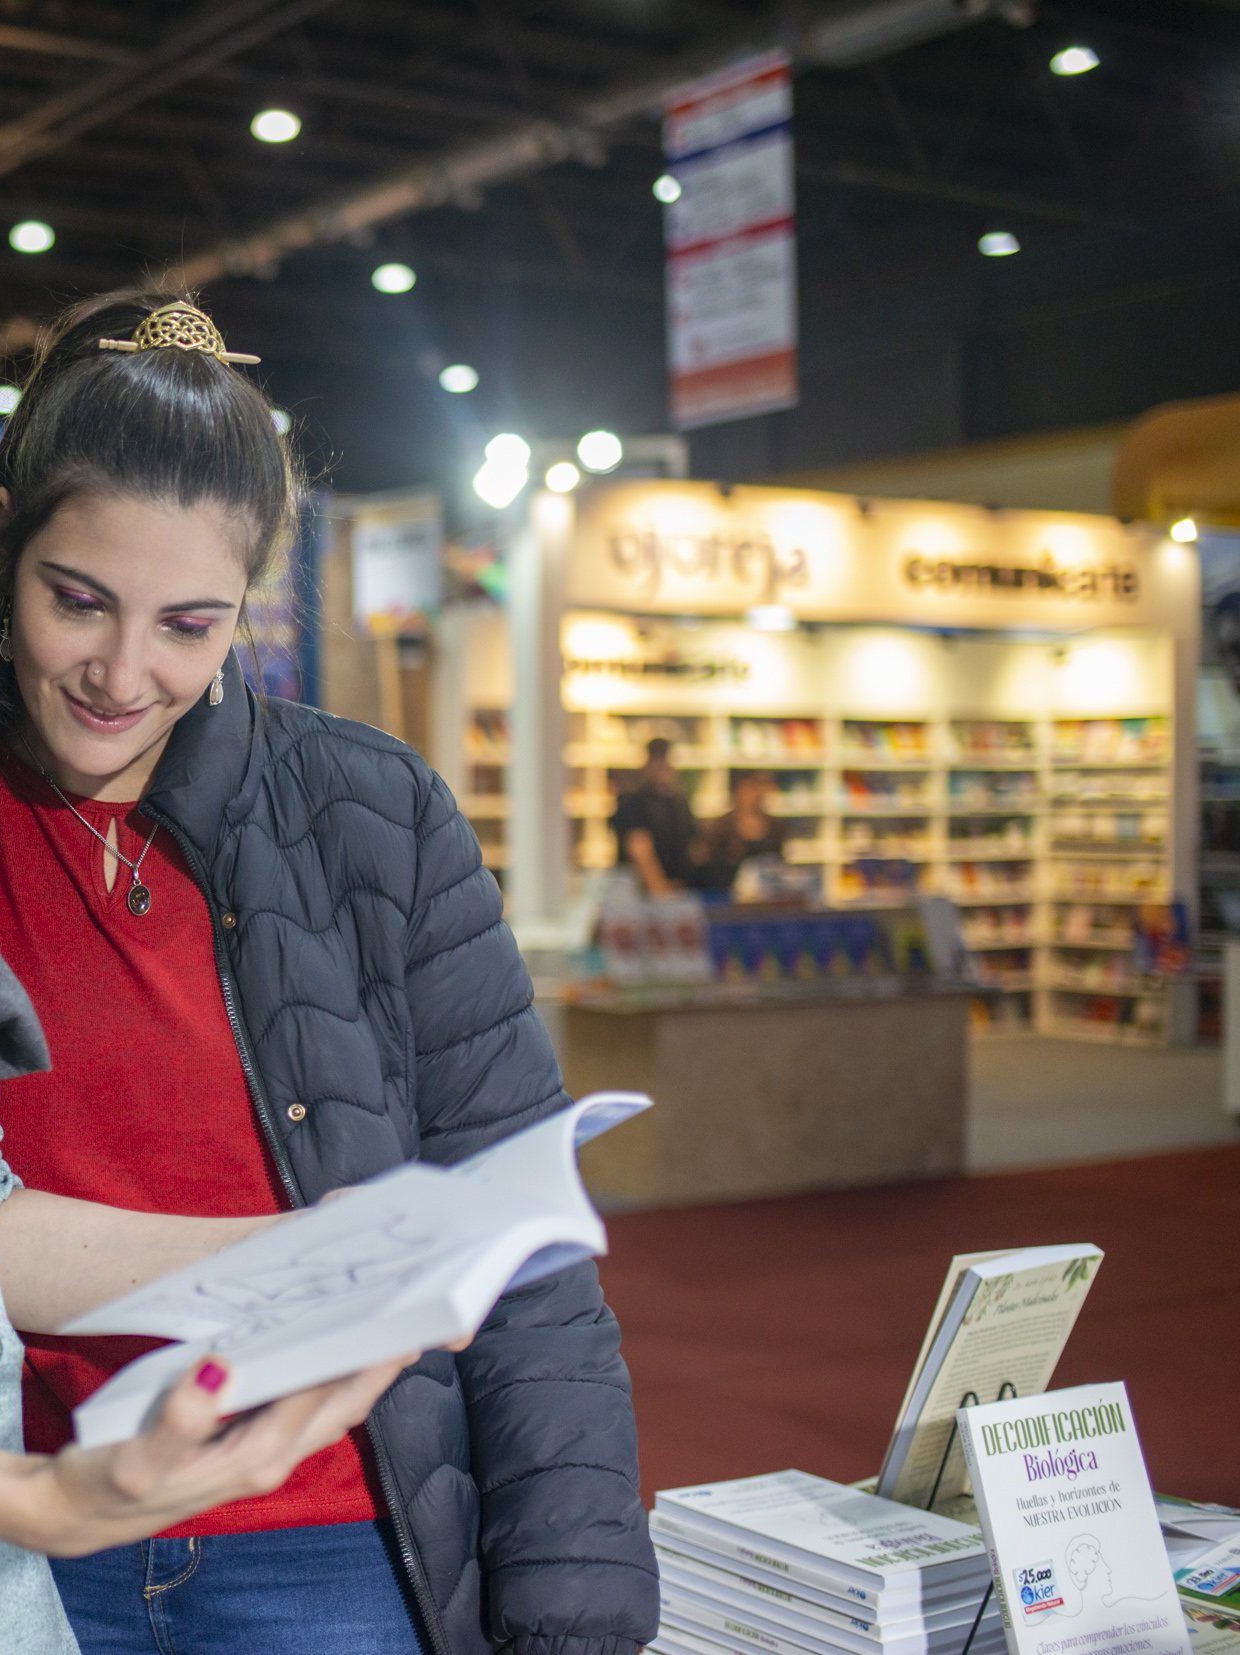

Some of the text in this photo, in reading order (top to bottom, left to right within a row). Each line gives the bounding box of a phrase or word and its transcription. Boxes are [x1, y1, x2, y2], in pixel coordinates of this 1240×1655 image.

[981, 1399, 1126, 1456] DECODIFICACIÓN
[1023, 1449, 1098, 1481] Biológica
[1016, 1494, 1049, 1511] Huellas
[1059, 1482, 1107, 1503] horizontes
[1109, 1479, 1121, 1493] de
[1023, 1496, 1123, 1528] NUESTRA EVOLUCIÓN
[1019, 1568, 1052, 1585] $25.000
[1034, 1584, 1055, 1601] kier
[1061, 1637, 1078, 1653] para
[1078, 1625, 1123, 1647] comprender
[1124, 1622, 1135, 1637] los
[1136, 1616, 1169, 1633] vínculos
